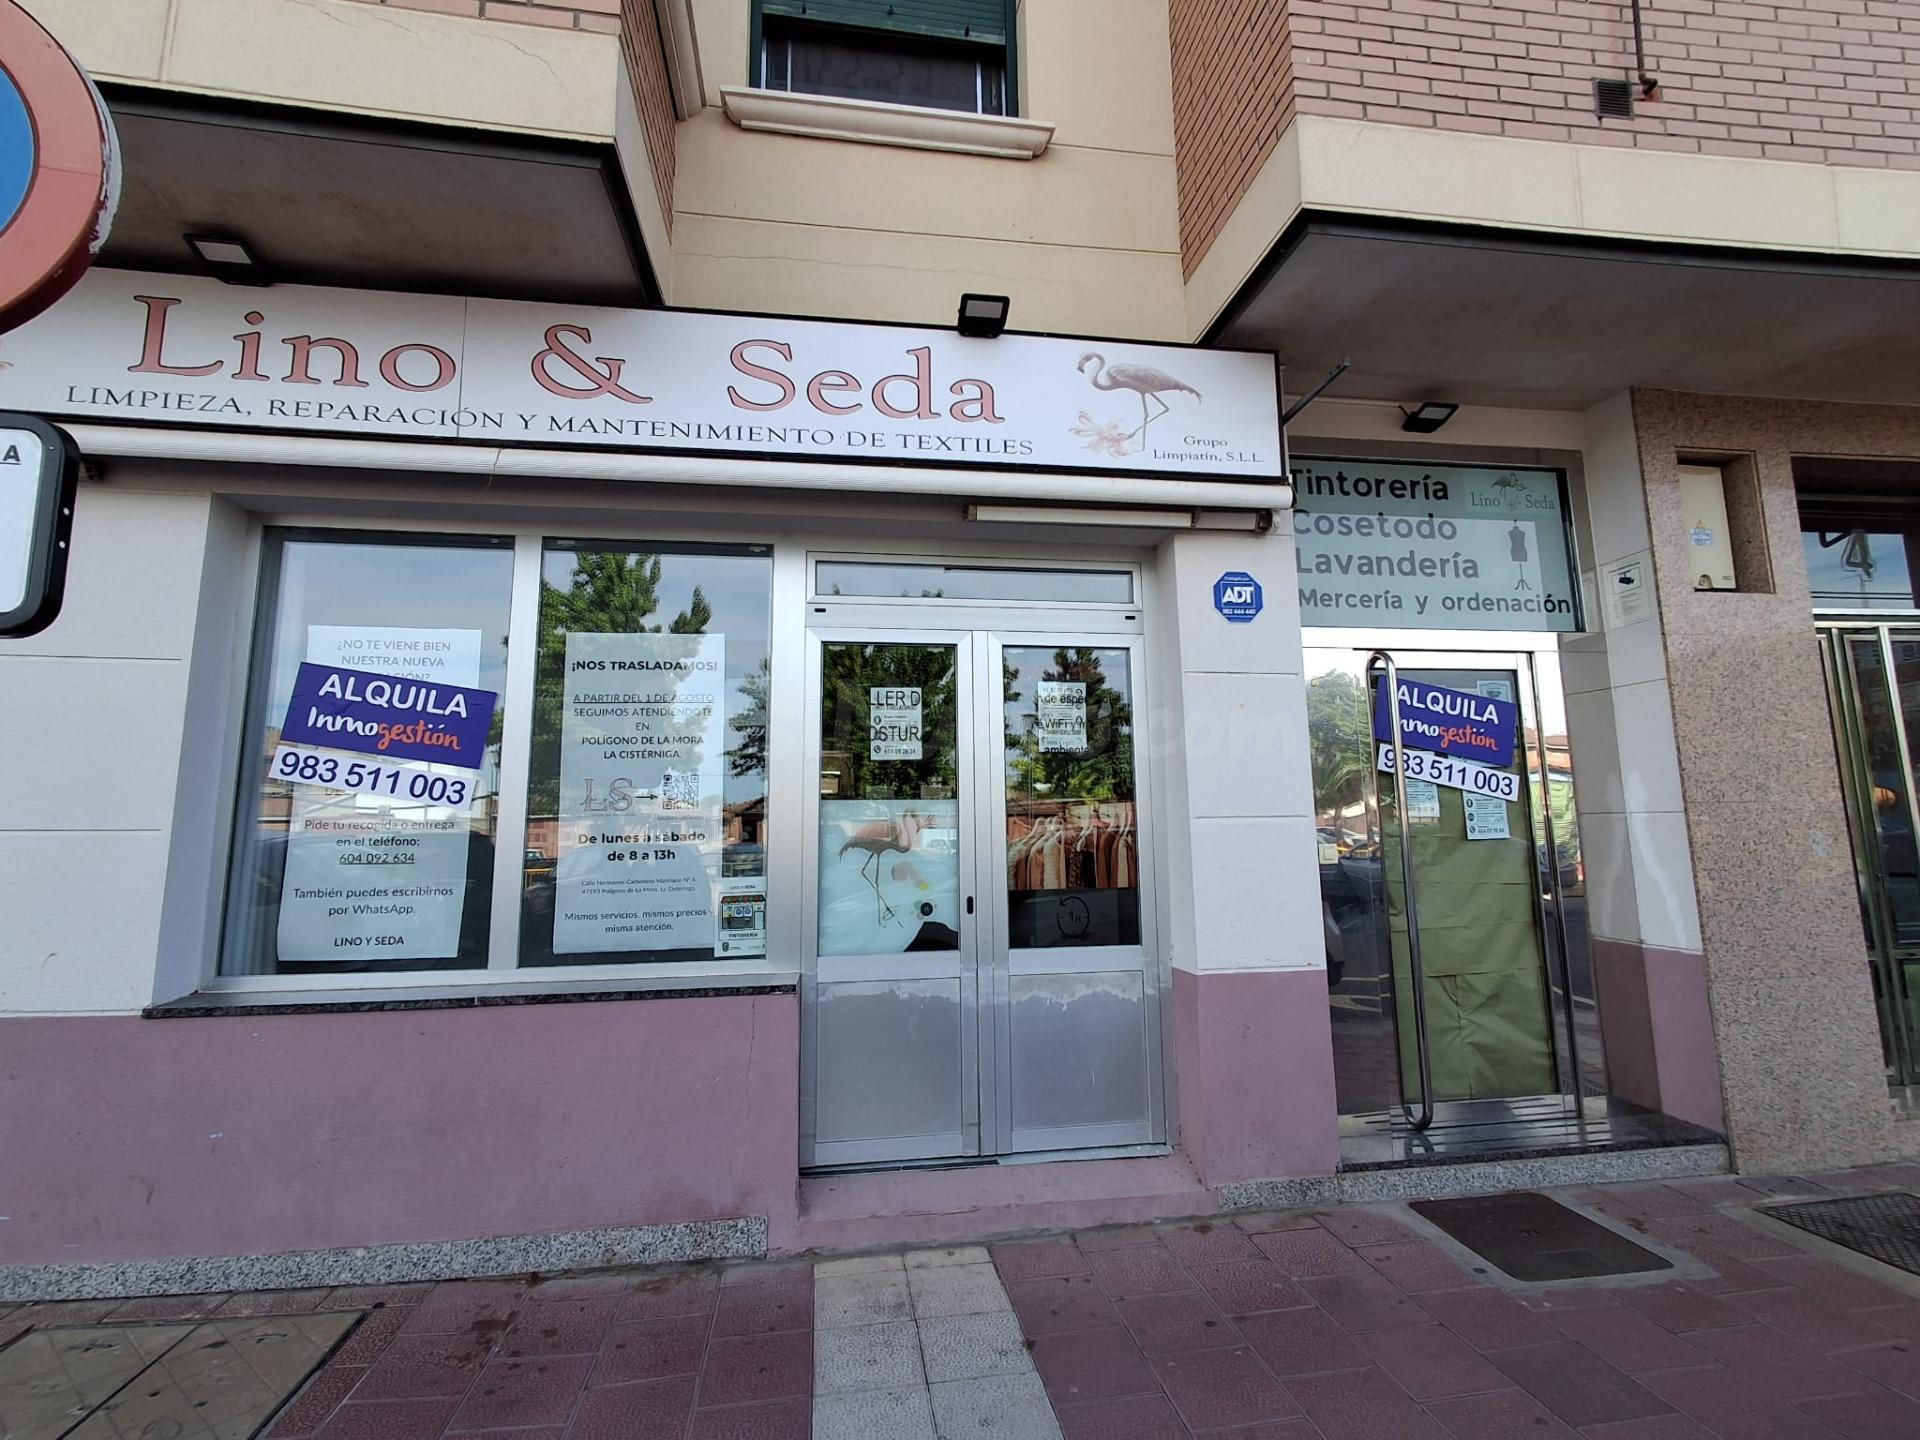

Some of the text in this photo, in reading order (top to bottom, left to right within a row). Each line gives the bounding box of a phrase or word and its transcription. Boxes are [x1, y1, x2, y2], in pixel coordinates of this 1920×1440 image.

[127, 295, 1005, 423] Lino & Seda
[67, 385, 1033, 455] LIMPIEZA, REPARACIÓN Y MANTENIMIENTO DE TEXTILES
[1183, 435, 1228, 448] Grupo
[1290, 468, 1449, 501] Tintorería
[1471, 491, 1556, 510] Lino Seda
[1292, 509, 1457, 541] Cosetodo
[1842, 529, 1876, 581] 4
[1296, 547, 1479, 579] Lavandería
[1222, 586, 1254, 604] ADT
[1298, 587, 1570, 615] Mercería y ordenación
[337, 639, 450, 652] ¿NO TE VIENE BIEN
[341, 655, 444, 667] NUESTRA NUEVA
[572, 661, 717, 671] ¡NOS TRASLADAMOS!
[318, 673, 467, 718] ALQUILA
[573, 694, 714, 702] A PARTIR DEL 1 DE AGOSTO
[1397, 685, 1499, 724] ALQUILA
[574, 707, 629, 717] SEGUIMOS
[307, 706, 462, 750] Inmogestión
[582, 735, 704, 745] POLÍGONO DE LA MORA
[603, 750, 617, 759] LA
[280, 751, 466, 805] 983 511 003
[1429, 759, 1468, 785] 511
[1474, 770, 1513, 796] 003
[305, 820, 329, 830] Pide
[333, 821, 344, 830] tu
[411, 820, 455, 832] entrega
[336, 835, 420, 847] en el teléfono:
[578, 831, 705, 844] De lunes a sábado
[339, 853, 415, 863] 604 092 634
[607, 850, 675, 862] de 8 a 13h
[294, 885, 454, 900] También puedes escribirnos
[328, 903, 416, 916] por WhatsApp.
[565, 912, 598, 921] Mismos
[642, 910, 674, 918] mismos
[676, 909, 707, 918] precios
[605, 922, 674, 933] misma atención.
[334, 936, 404, 947] LINO Y SEDA
